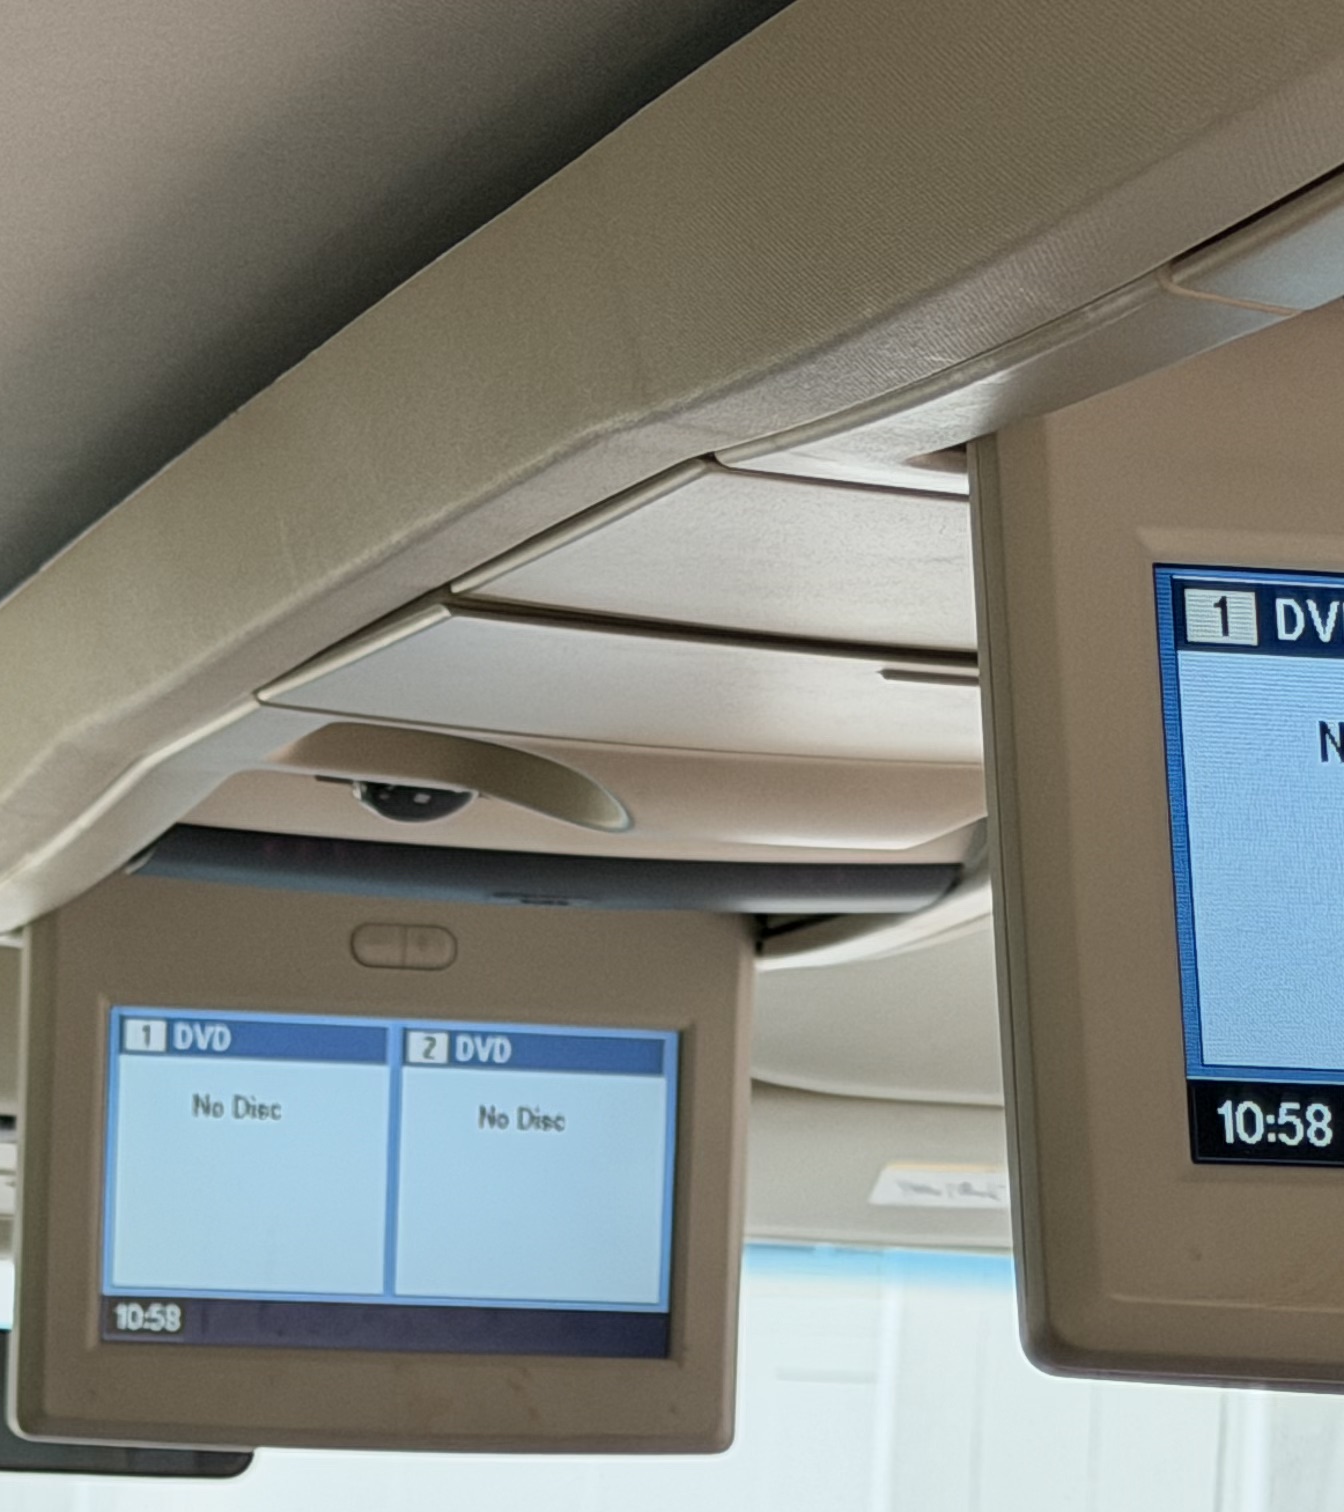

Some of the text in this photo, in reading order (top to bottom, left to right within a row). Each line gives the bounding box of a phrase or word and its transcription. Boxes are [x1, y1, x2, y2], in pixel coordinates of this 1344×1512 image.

[1213, 595, 1230, 636] 1
[141, 1022, 232, 1051] 1 DVD
[422, 1034, 513, 1063] 2 DVD
[193, 1093, 282, 1121] No Disc
[478, 1104, 566, 1133] No Disc
[1216, 1099, 1335, 1147] 10:58
[113, 1302, 182, 1332] 10:58
